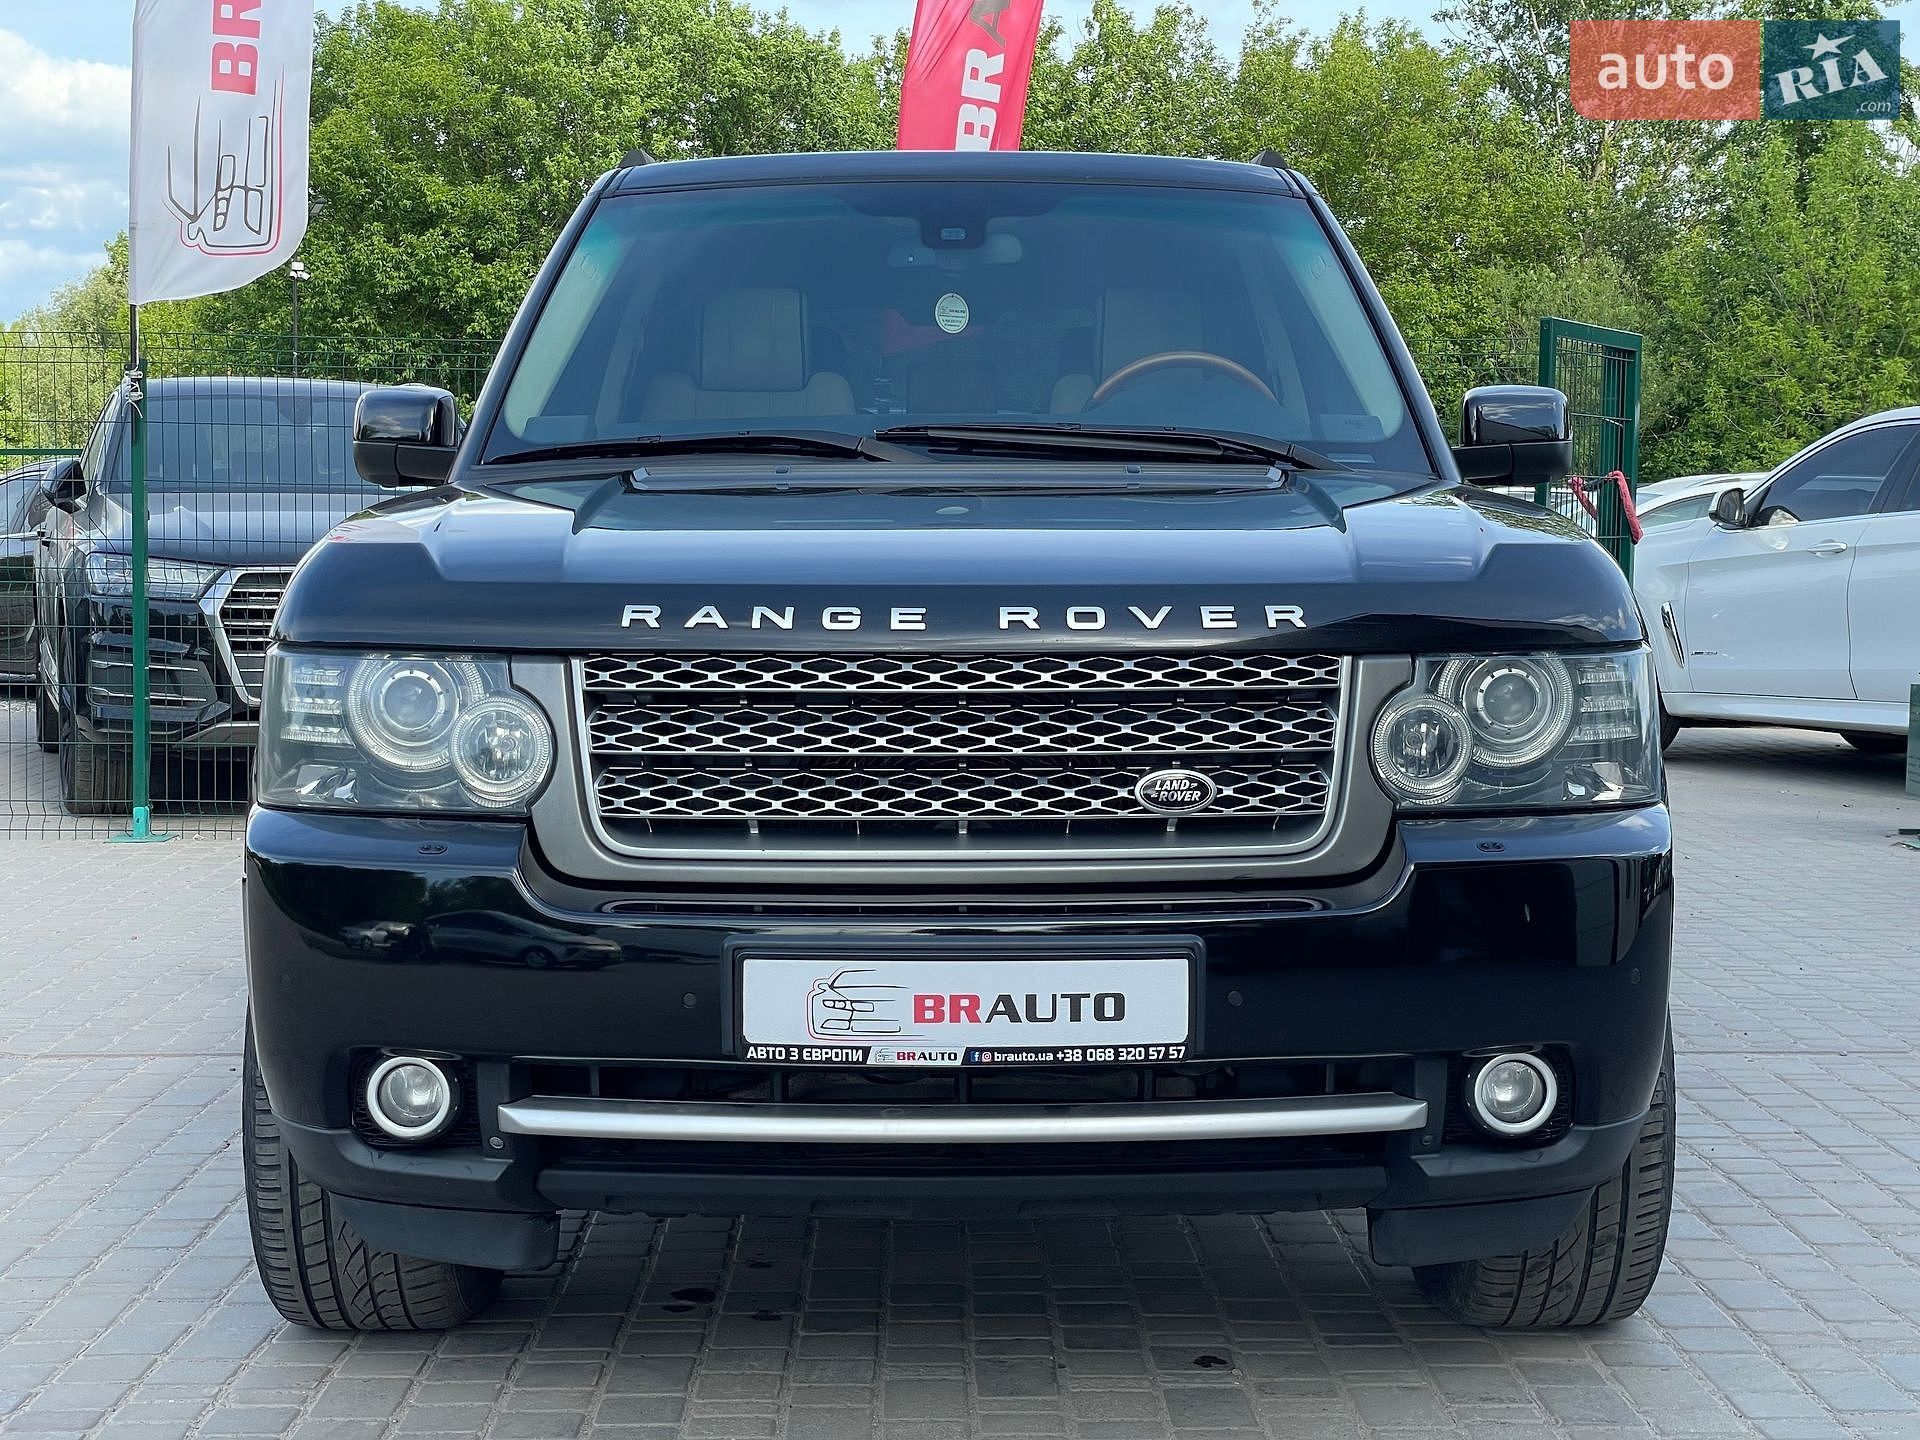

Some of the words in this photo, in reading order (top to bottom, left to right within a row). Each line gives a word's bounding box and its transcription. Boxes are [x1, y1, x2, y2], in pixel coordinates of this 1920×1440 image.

[621, 604, 927, 631] RANGE
[999, 604, 1308, 630] ROVER
[1155, 780, 1190, 791] LAND
[1158, 790, 1202, 802] ROVER
[913, 992, 1126, 1024] BRAUTO
[746, 1046, 786, 1060] АВТО
[802, 1048, 863, 1062] ЄВРОПИ
[896, 1051, 958, 1061] BRAUTO
[993, 1050, 1054, 1062] brauto.ua
[1056, 1049, 1083, 1062] +38
[1086, 1048, 1115, 1062] 068
[1118, 1047, 1145, 1061] 320
[1148, 1046, 1166, 1060] 57
[1168, 1045, 1186, 1060] 57
